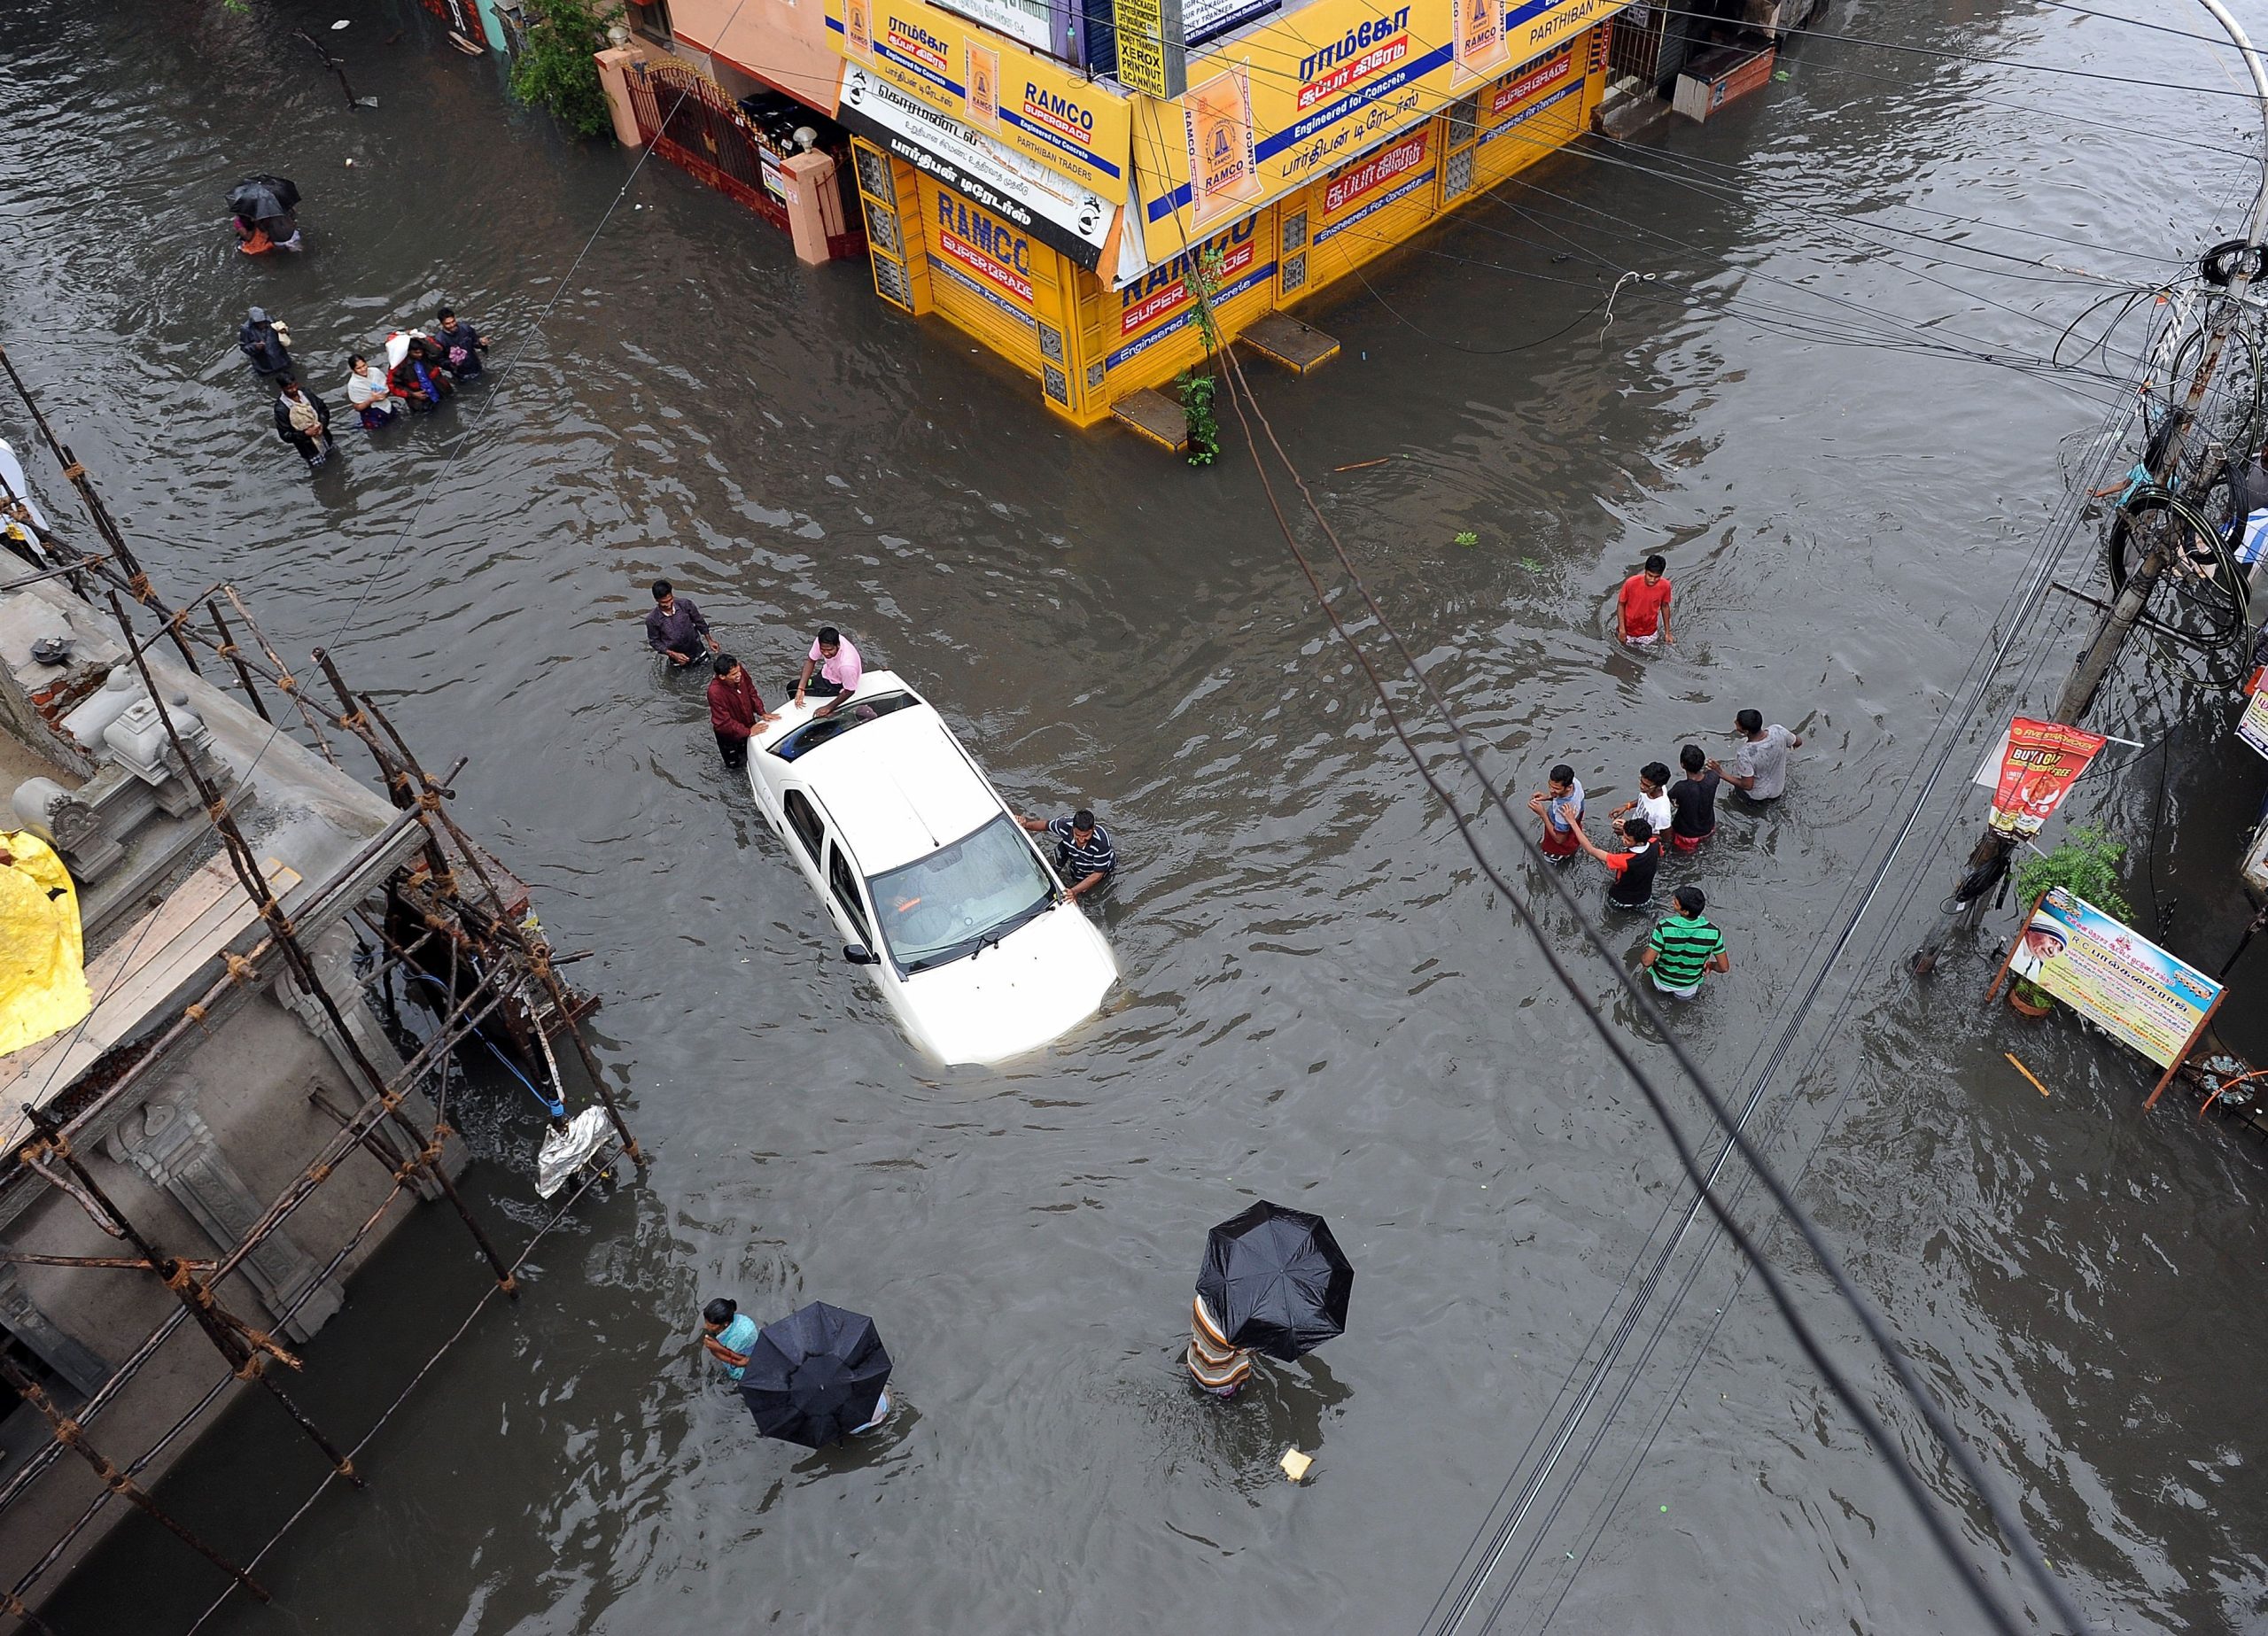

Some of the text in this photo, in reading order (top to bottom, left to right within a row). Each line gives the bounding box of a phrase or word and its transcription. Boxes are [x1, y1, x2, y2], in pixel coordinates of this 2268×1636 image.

[1202, 4, 1233, 21] TRANSFER
[1529, 0, 1594, 46] PARTHIBAN
[889, 16, 949, 56] ராம்கோ
[1120, 29, 1135, 45] MONEY
[1136, 35, 1160, 55] TRANSFER
[1299, 5, 1410, 85] ராம்கோ
[1464, 27, 1496, 50] RAMCO
[886, 49, 946, 86] Engineered for Concrete
[1122, 44, 1161, 69] XEROX
[1122, 58, 1161, 81] PRINTOUT
[1122, 69, 1162, 94] SCANNING
[973, 97, 993, 112] RAMCO
[1024, 103, 1090, 143] SUPERGRADE
[1025, 81, 1093, 130] RAMCO
[1294, 72, 1406, 138] Engineered for Concrete
[1020, 119, 1089, 160] Engineered for Concrete
[1184, 111, 1195, 157] RAMCO
[1247, 131, 1255, 174] RAMCO
[1017, 136, 1092, 182] PARTHIBAN TRADERS
[1205, 159, 1244, 190] RAMCO
[1320, 205, 1368, 241] Engineered
[1386, 177, 1423, 205] Concrete
[937, 190, 1030, 277] RAMCO
[1211, 279, 1251, 307] oncrete
[1120, 316, 1184, 361] Engineered
[2023, 729, 2042, 738] FIVE
[2043, 733, 2064, 742] STAR
[2013, 748, 2037, 763] BUY
[2052, 768, 2072, 778] FREE
